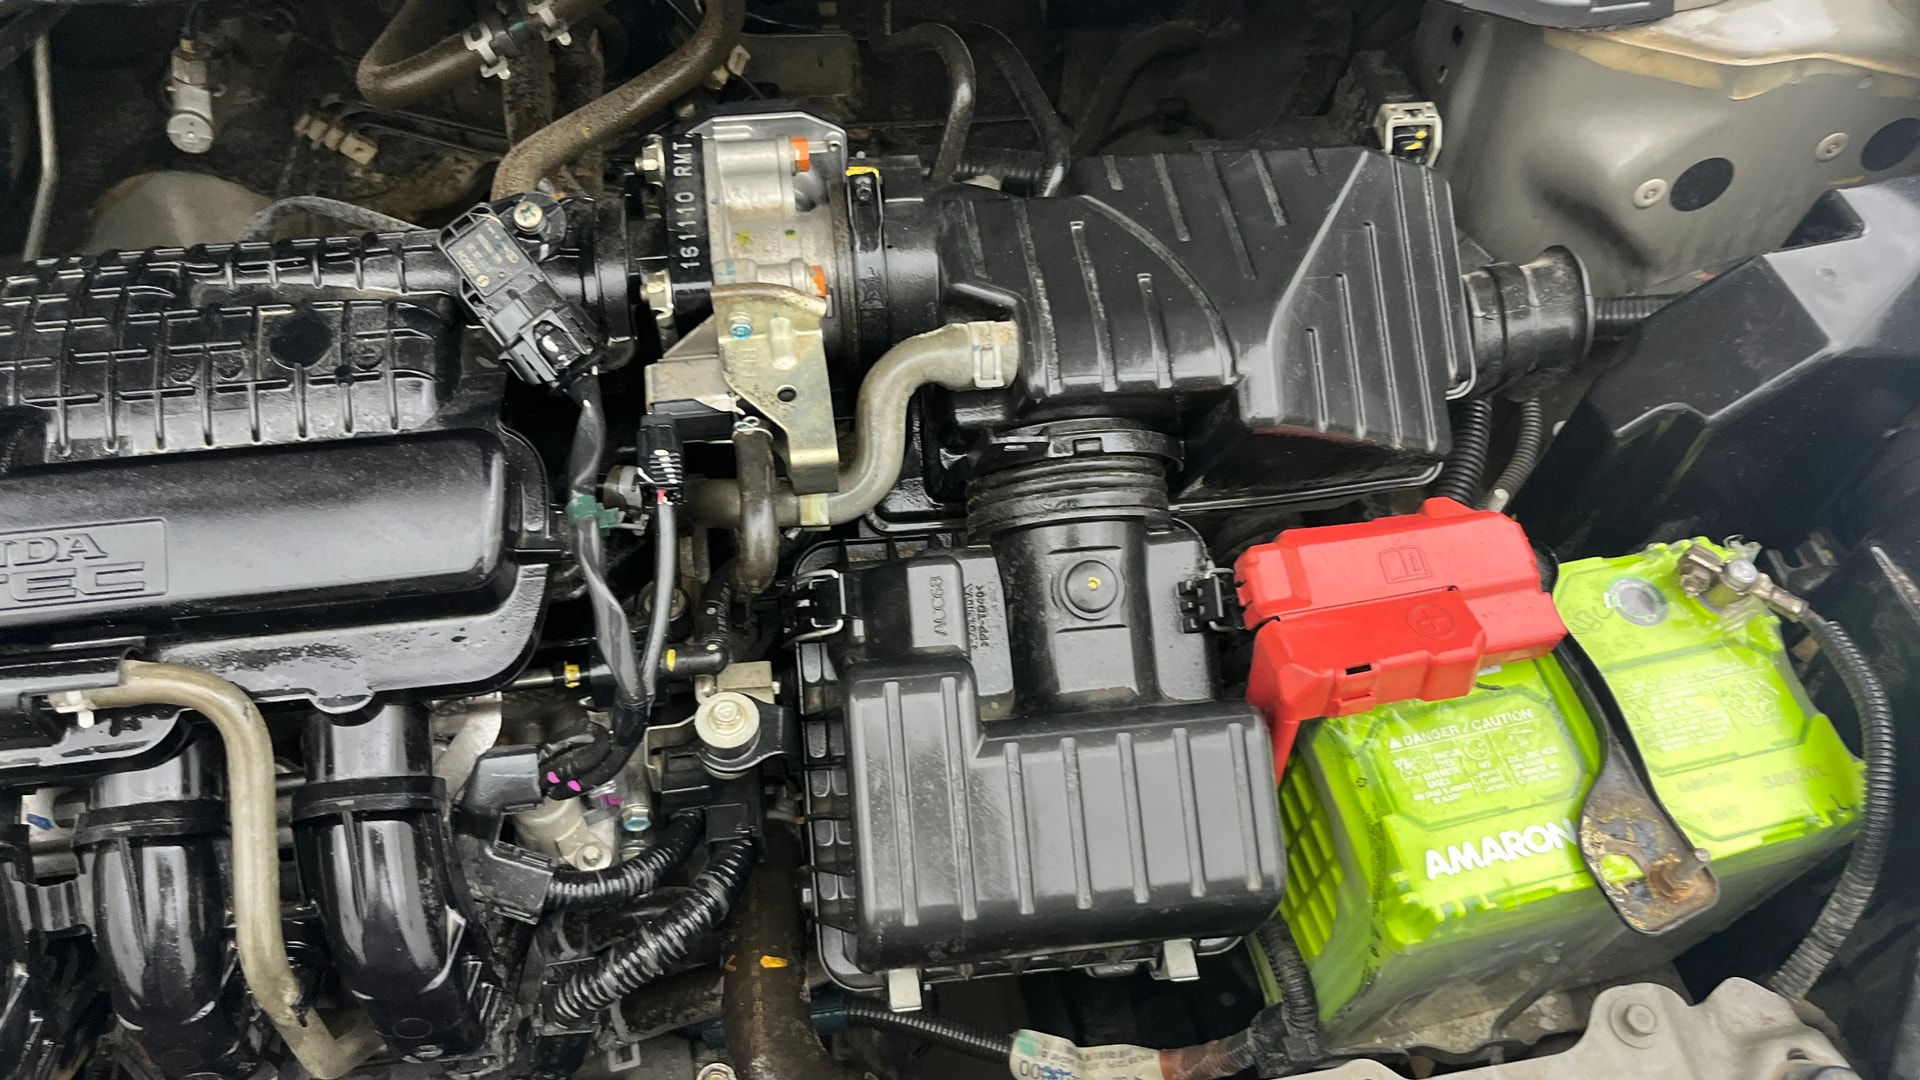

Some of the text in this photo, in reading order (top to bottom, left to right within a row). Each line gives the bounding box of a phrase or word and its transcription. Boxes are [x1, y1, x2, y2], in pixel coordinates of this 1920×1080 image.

[672, 142, 701, 269] 161110 RMT
[1404, 725, 1459, 746] DANGER
[1471, 709, 1534, 731] CAUTION
[1425, 817, 1577, 880] AMARON
